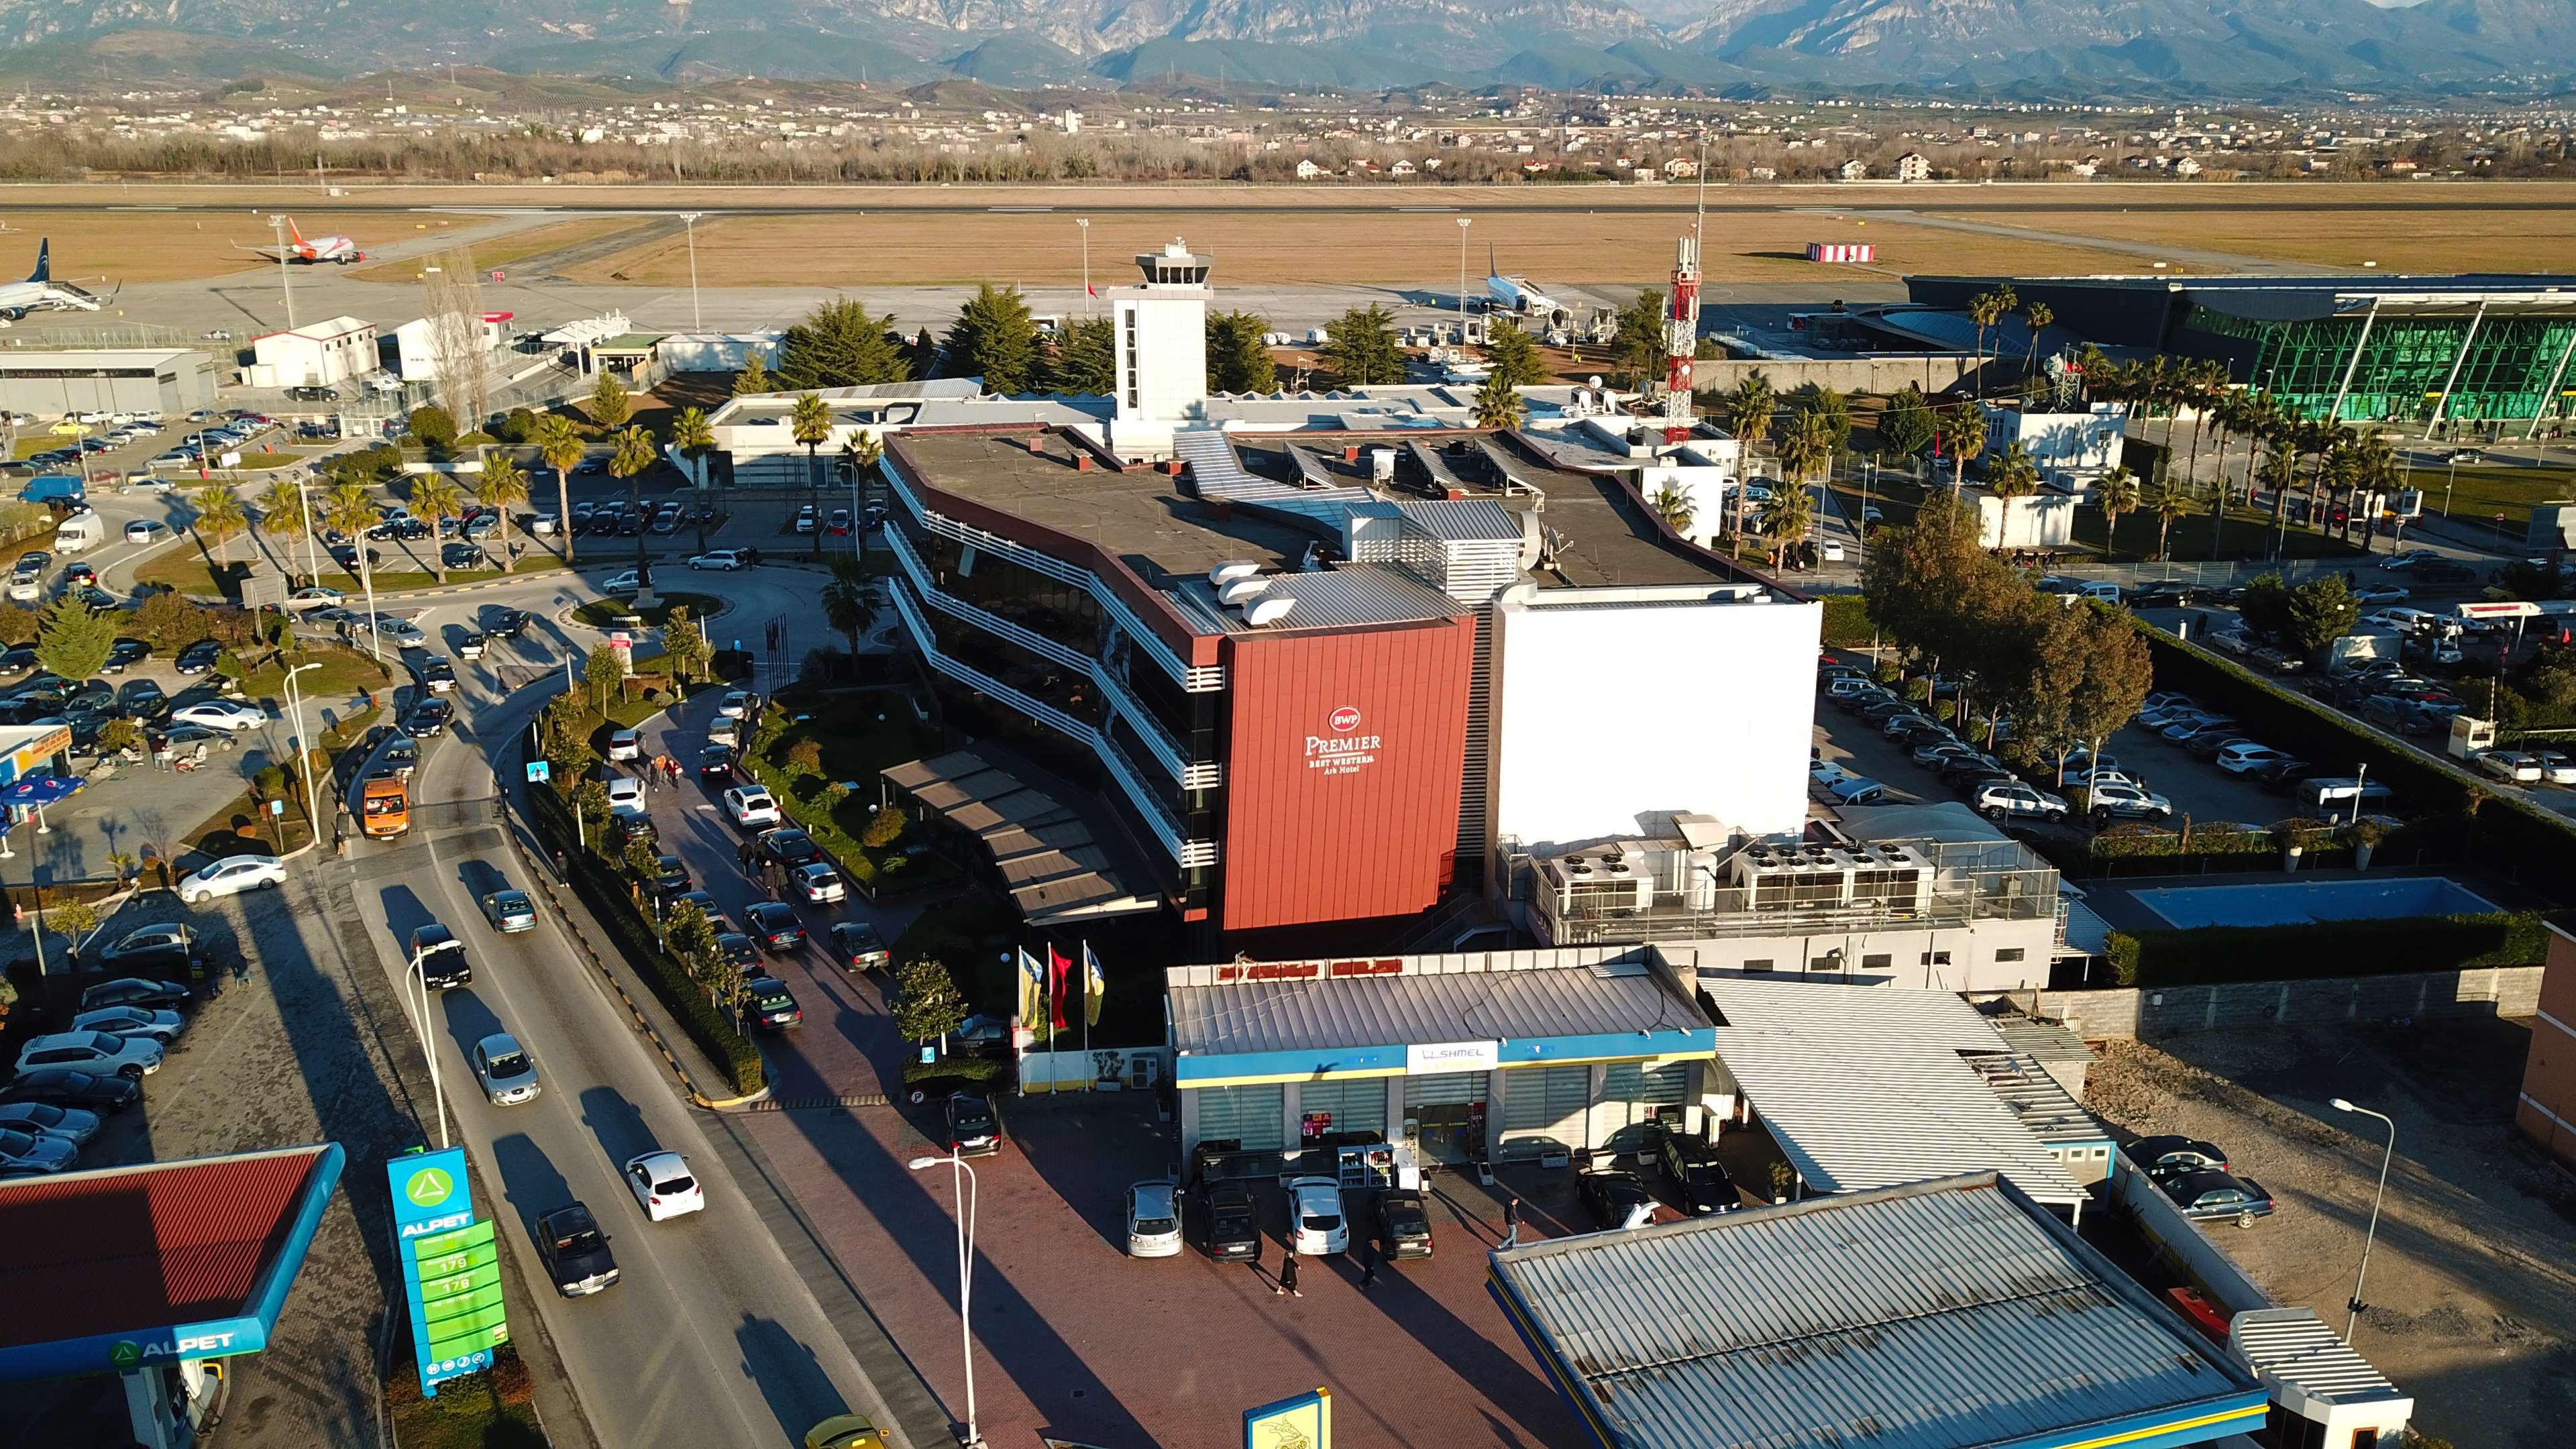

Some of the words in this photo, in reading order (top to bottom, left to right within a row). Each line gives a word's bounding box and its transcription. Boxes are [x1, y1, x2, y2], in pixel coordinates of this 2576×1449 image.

[1334, 715, 1358, 725] BWP
[1305, 735, 1381, 755] PREMIER
[1309, 759, 1331, 768] BEST
[1332, 756, 1375, 766] WESTERN
[1339, 765, 1360, 774] Hotel
[1440, 1049, 1484, 1057] SHMEL
[401, 1212, 470, 1238] ALPET
[440, 1258, 467, 1273] 179
[443, 1279, 470, 1293] 178
[142, 1332, 234, 1357] ALPET
